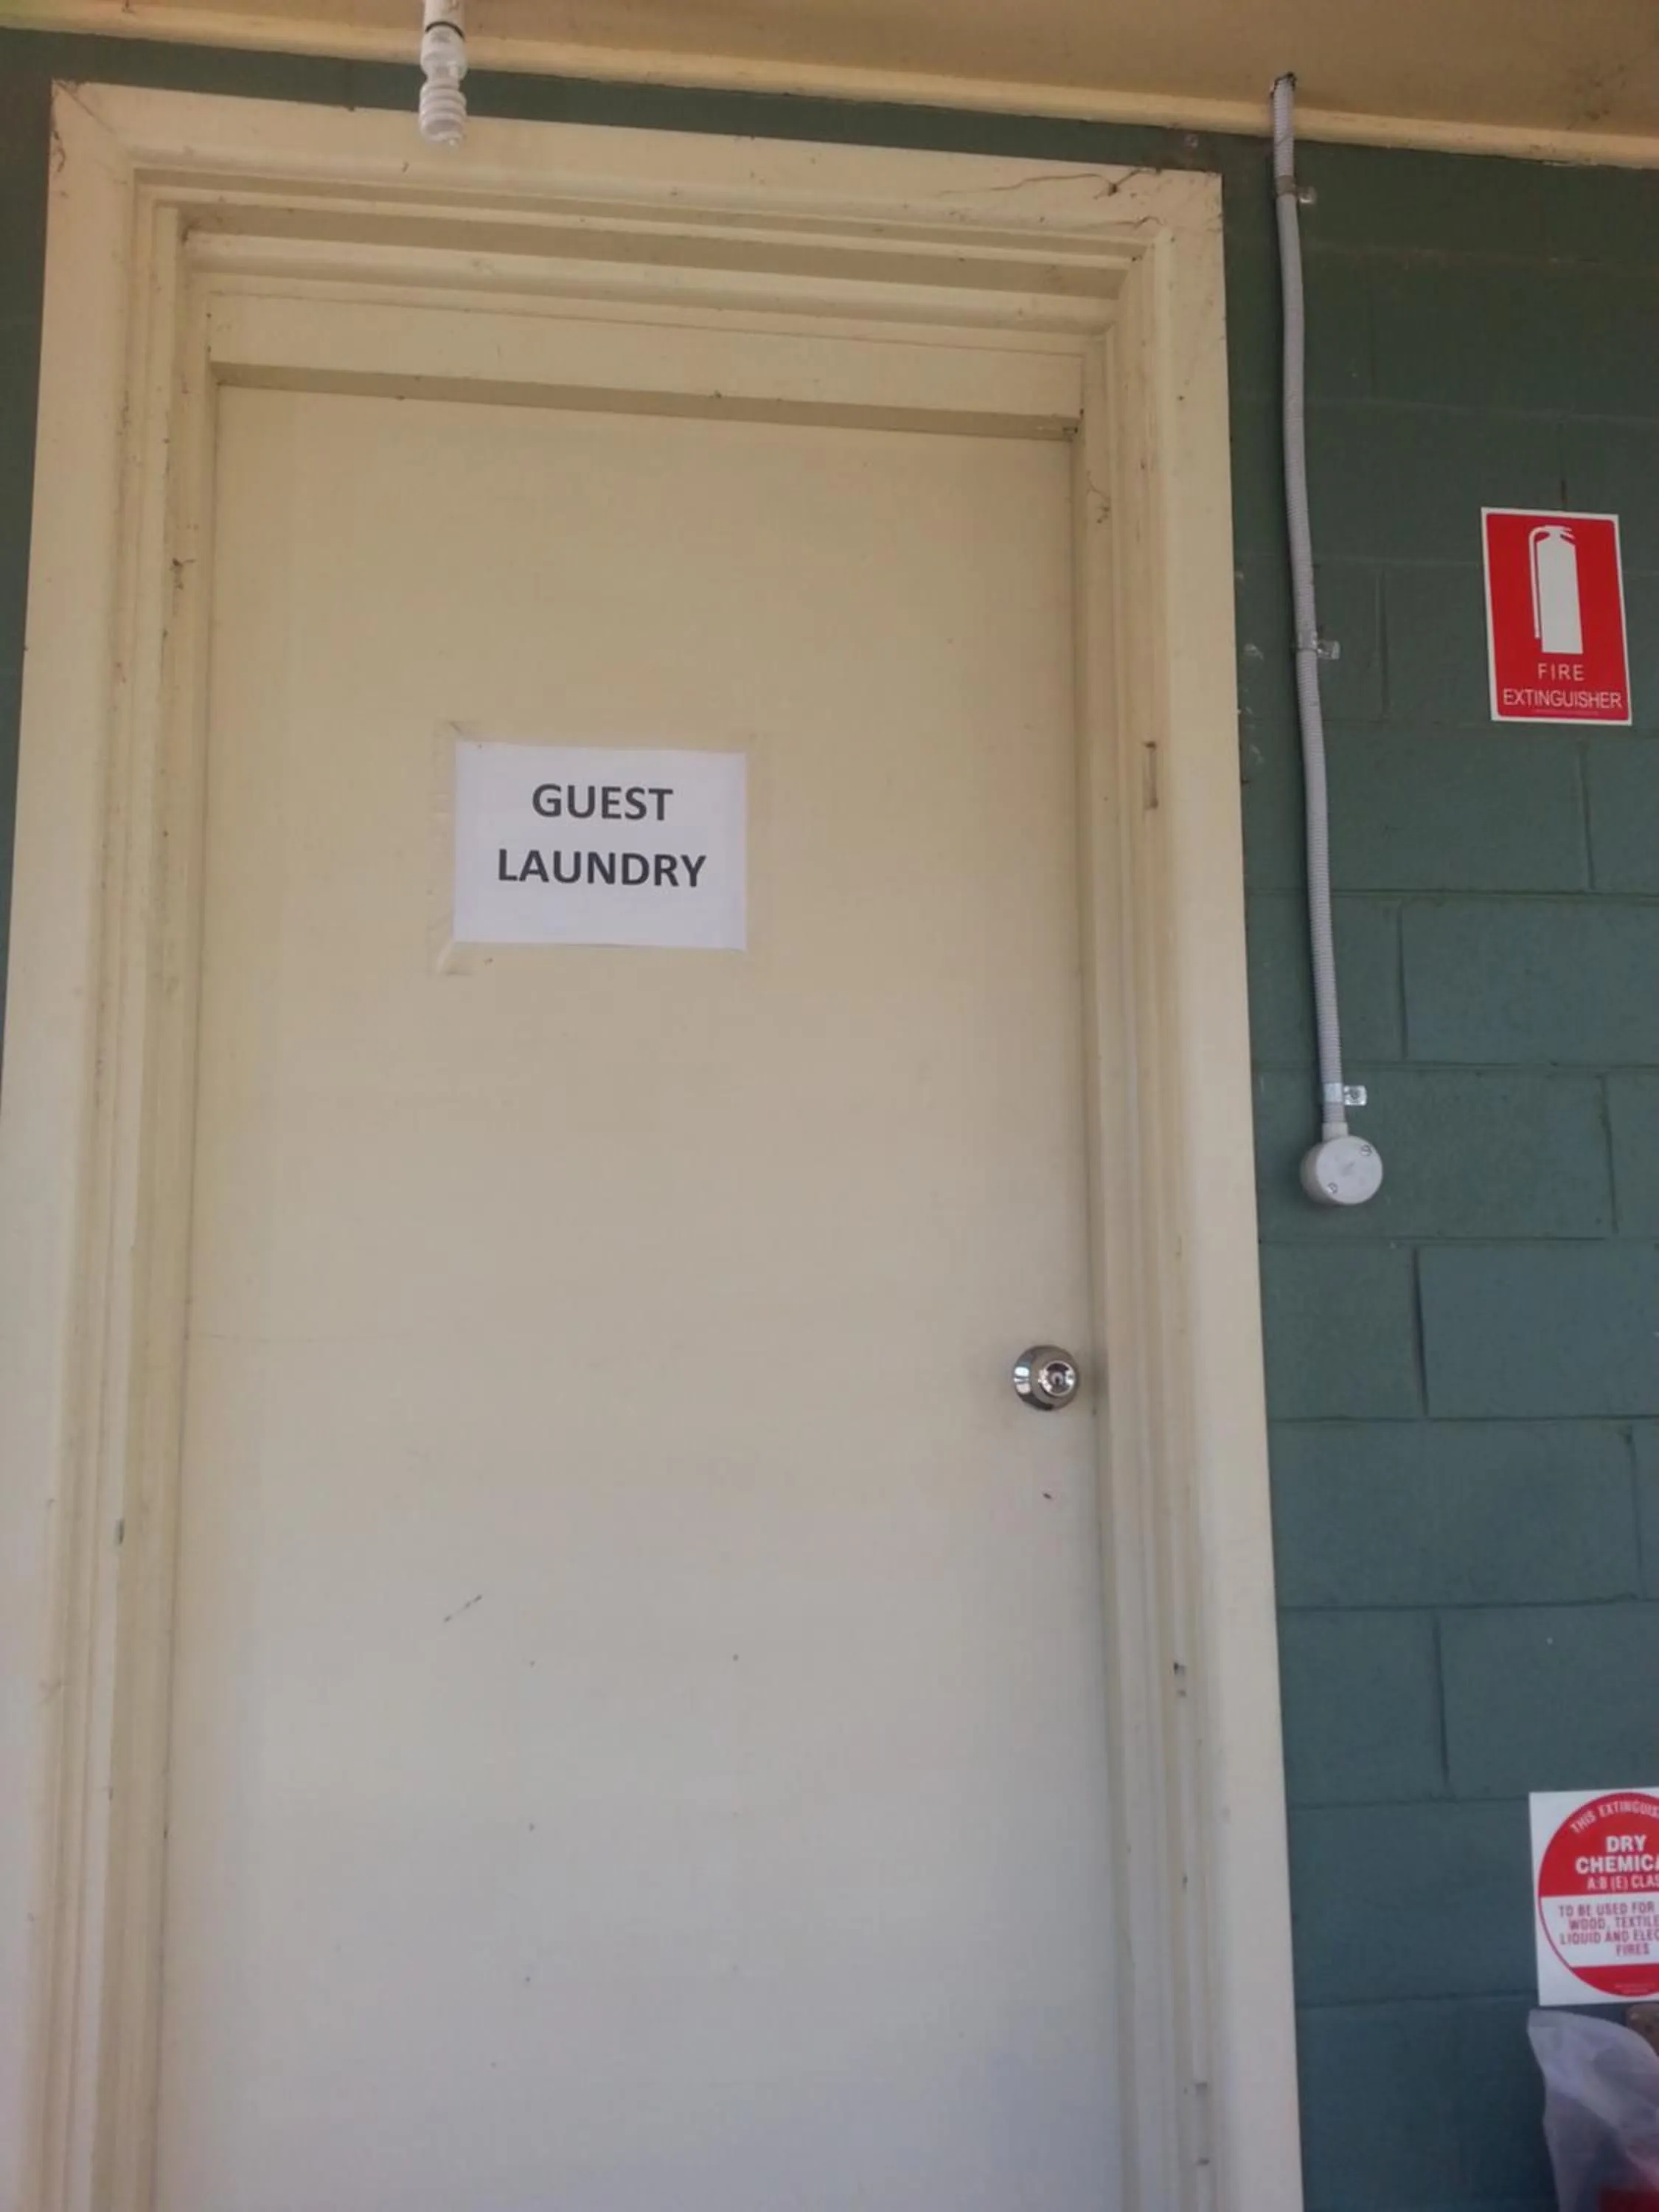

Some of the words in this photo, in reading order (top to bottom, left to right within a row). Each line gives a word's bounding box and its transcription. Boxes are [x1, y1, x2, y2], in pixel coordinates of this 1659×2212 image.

[1537, 662, 1585, 682] FIRE
[1503, 688, 1623, 709] EXTINGUISHER
[532, 783, 674, 821] GUEST
[498, 848, 707, 888] LAUNDRY
[1570, 1810, 1597, 1834] THIS
[1605, 1834, 1647, 1853] DRY
[1558, 1905, 1574, 1917] TO
[1578, 1904, 1590, 1916] BE
[1596, 1902, 1628, 1916] USED
[1631, 1901, 1654, 1914] FOR
[1559, 1932, 1601, 1945] LIQUID
[1604, 1930, 1630, 1943] AND
[1615, 1942, 1650, 1957] FIRES
